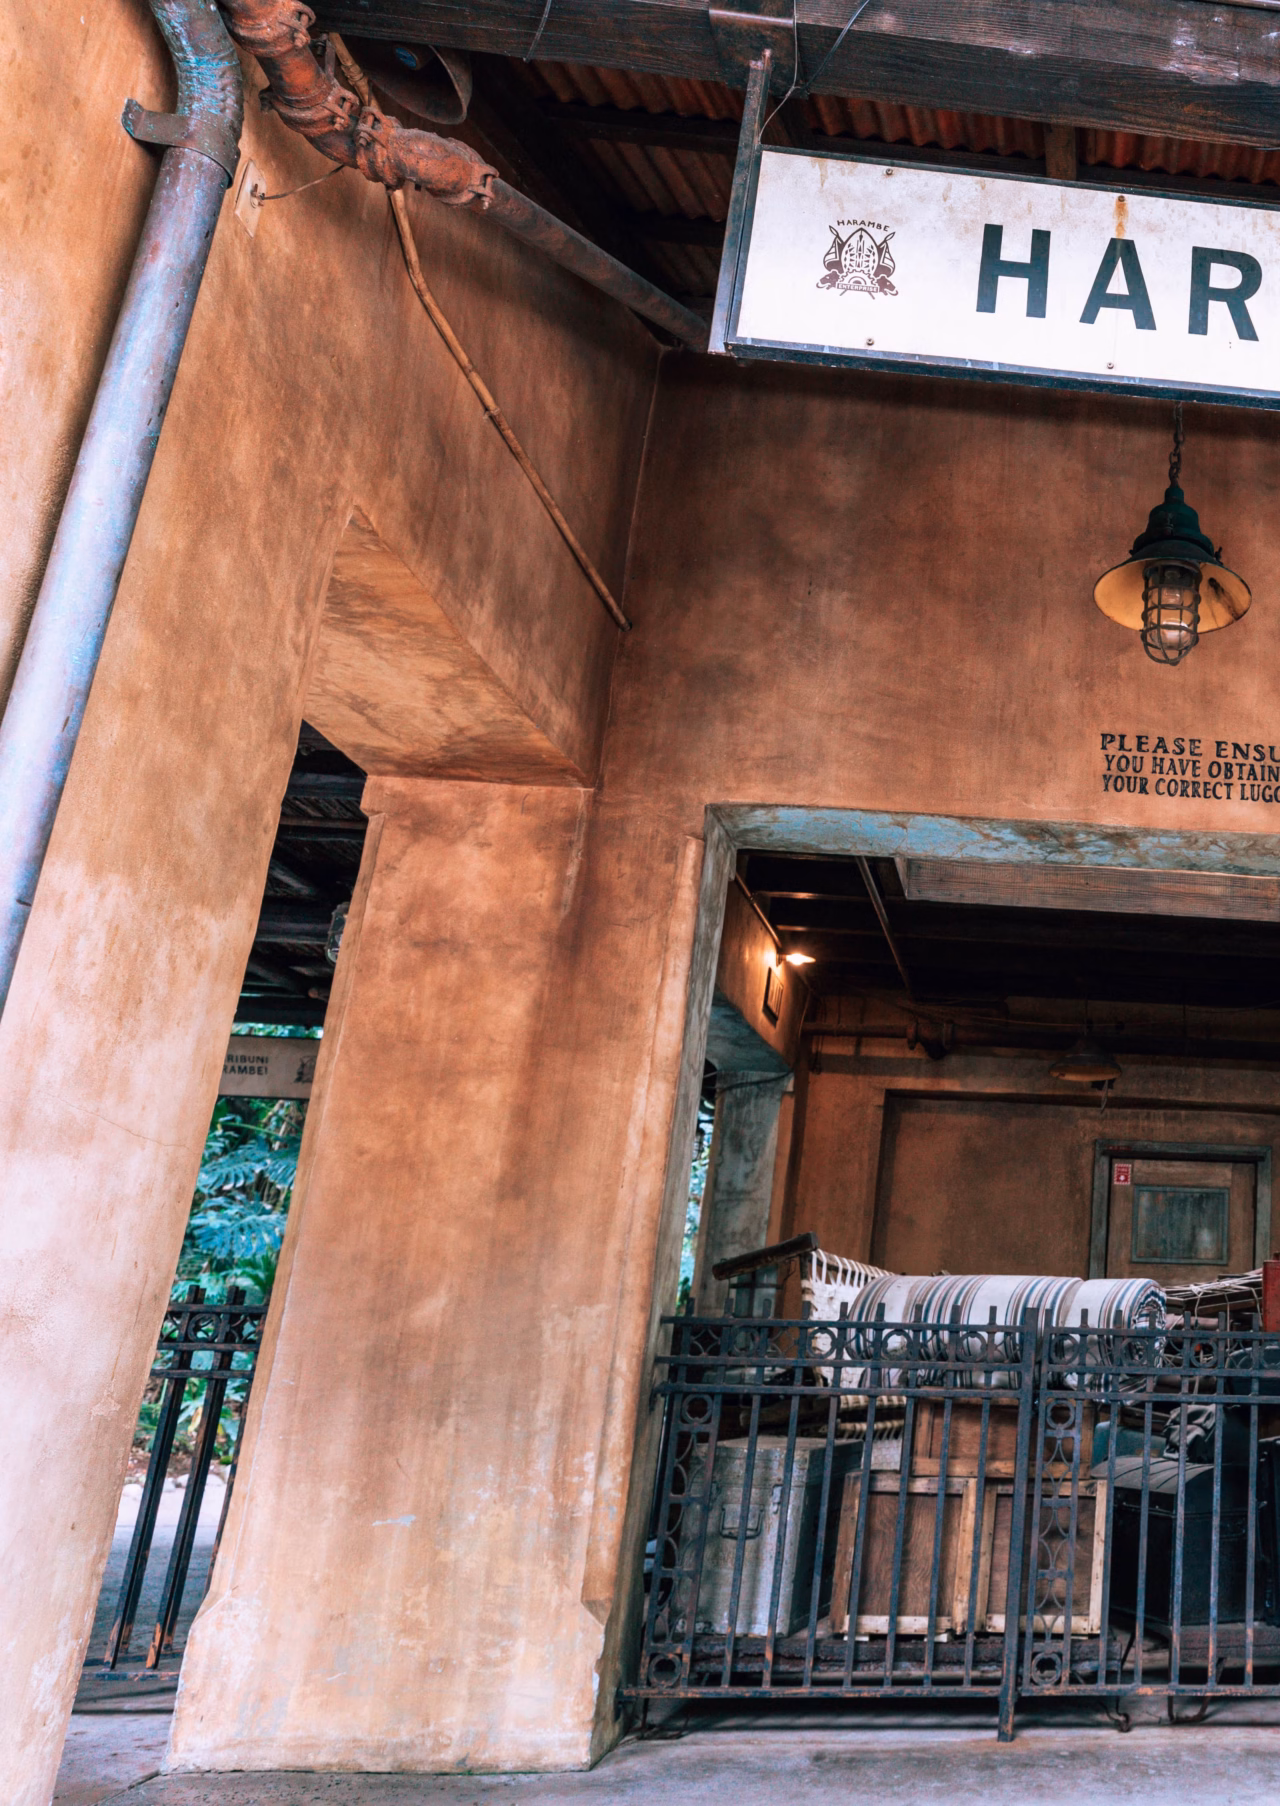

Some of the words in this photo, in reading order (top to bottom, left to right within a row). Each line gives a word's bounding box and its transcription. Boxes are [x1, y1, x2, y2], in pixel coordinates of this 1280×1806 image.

[837, 219, 890, 232] HARAMBE
[839, 283, 877, 292] ENTERPRISE
[1100, 733, 1203, 757] PLEASE
[1104, 754, 1144, 774] YOU
[1151, 756, 1201, 778] HAVE
[1102, 774, 1149, 795] YOUR
[1155, 777, 1234, 800] CORRECT
